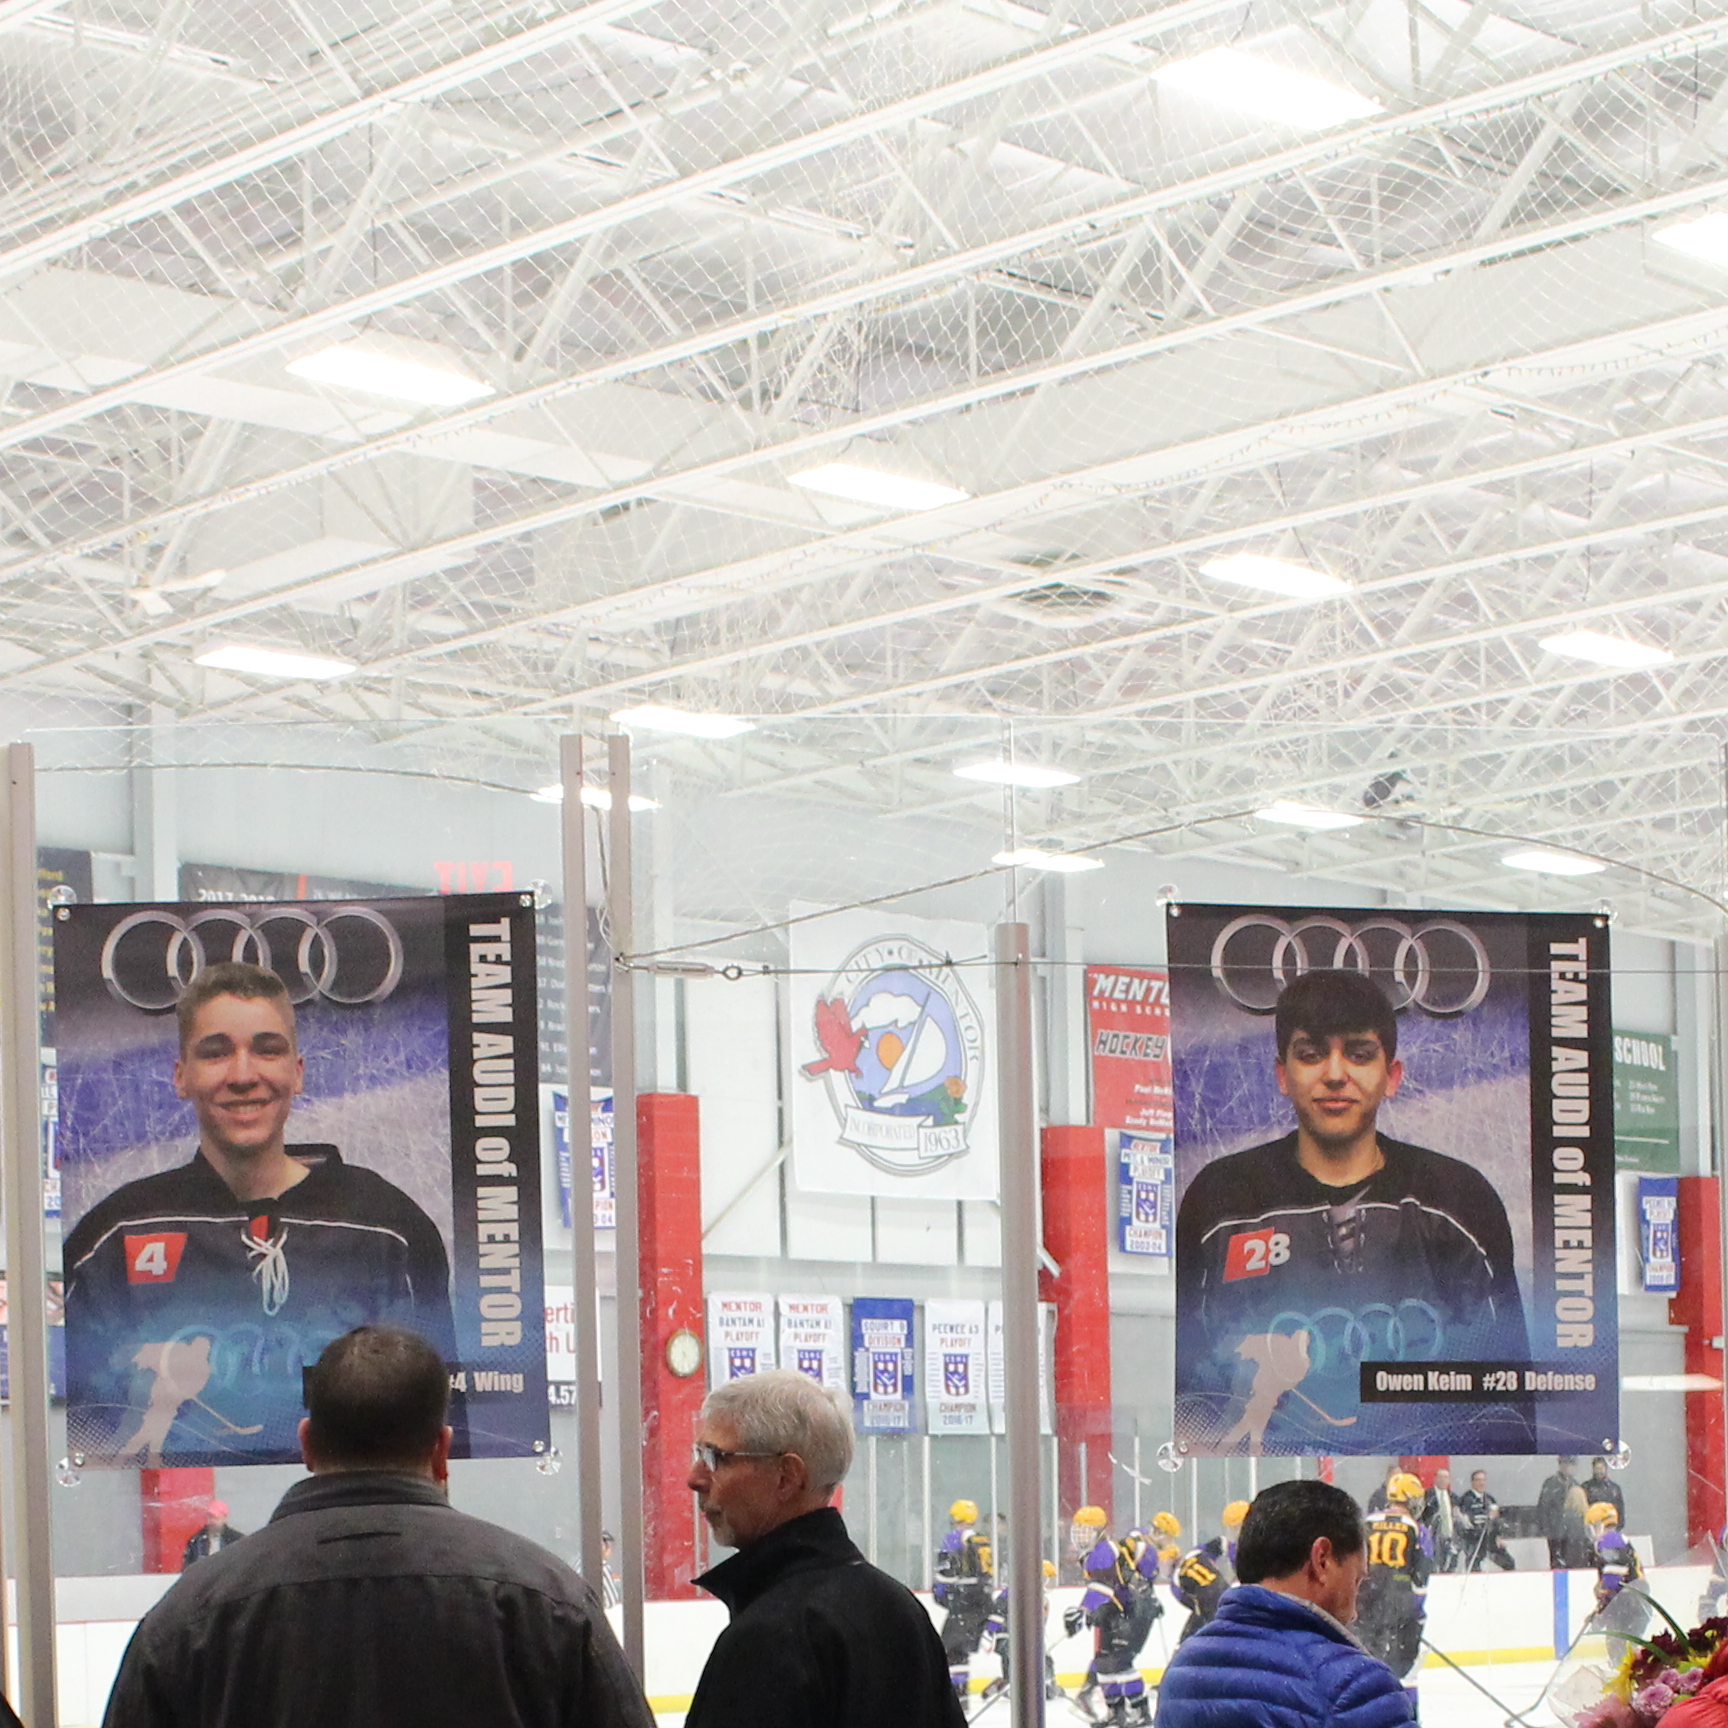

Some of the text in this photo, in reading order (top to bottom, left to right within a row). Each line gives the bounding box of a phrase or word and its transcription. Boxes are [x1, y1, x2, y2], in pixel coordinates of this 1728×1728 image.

[1092, 1000, 1128, 1013] HIGH
[1095, 1030, 1167, 1061] HOCKEY
[1614, 1035, 1666, 1071] SCHOOL
[469, 917, 522, 1348] TEAM AUDI of MENTOR
[923, 1128, 961, 1152] 1963
[1549, 937, 1595, 1349] TEAM AUDI of MENTOR
[1129, 1228, 1163, 1239] CHAMPION
[133, 1242, 168, 1276] 4
[1243, 1233, 1291, 1271] 28
[545, 1303, 577, 1324] erti
[722, 1302, 763, 1313] MENTOR
[788, 1304, 829, 1315] MENTOR
[719, 1316, 754, 1329] BANTAM
[787, 1318, 821, 1330] BANTAM
[932, 1323, 966, 1335] PEEWEE
[724, 1331, 761, 1344] PLAYOFF
[793, 1331, 828, 1344] PLAYOFF
[867, 1334, 902, 1347] DIVISION
[939, 1336, 972, 1348] PLAYOFF
[473, 1371, 525, 1394] Wing
[1375, 1369, 1425, 1391] Owen
[1427, 1369, 1473, 1391] Keim
[1525, 1370, 1596, 1391] Defense
[547, 1384, 577, 1405] 4.57
[939, 1402, 977, 1413] CHAMPION
[1368, 1531, 1408, 1568] 10
